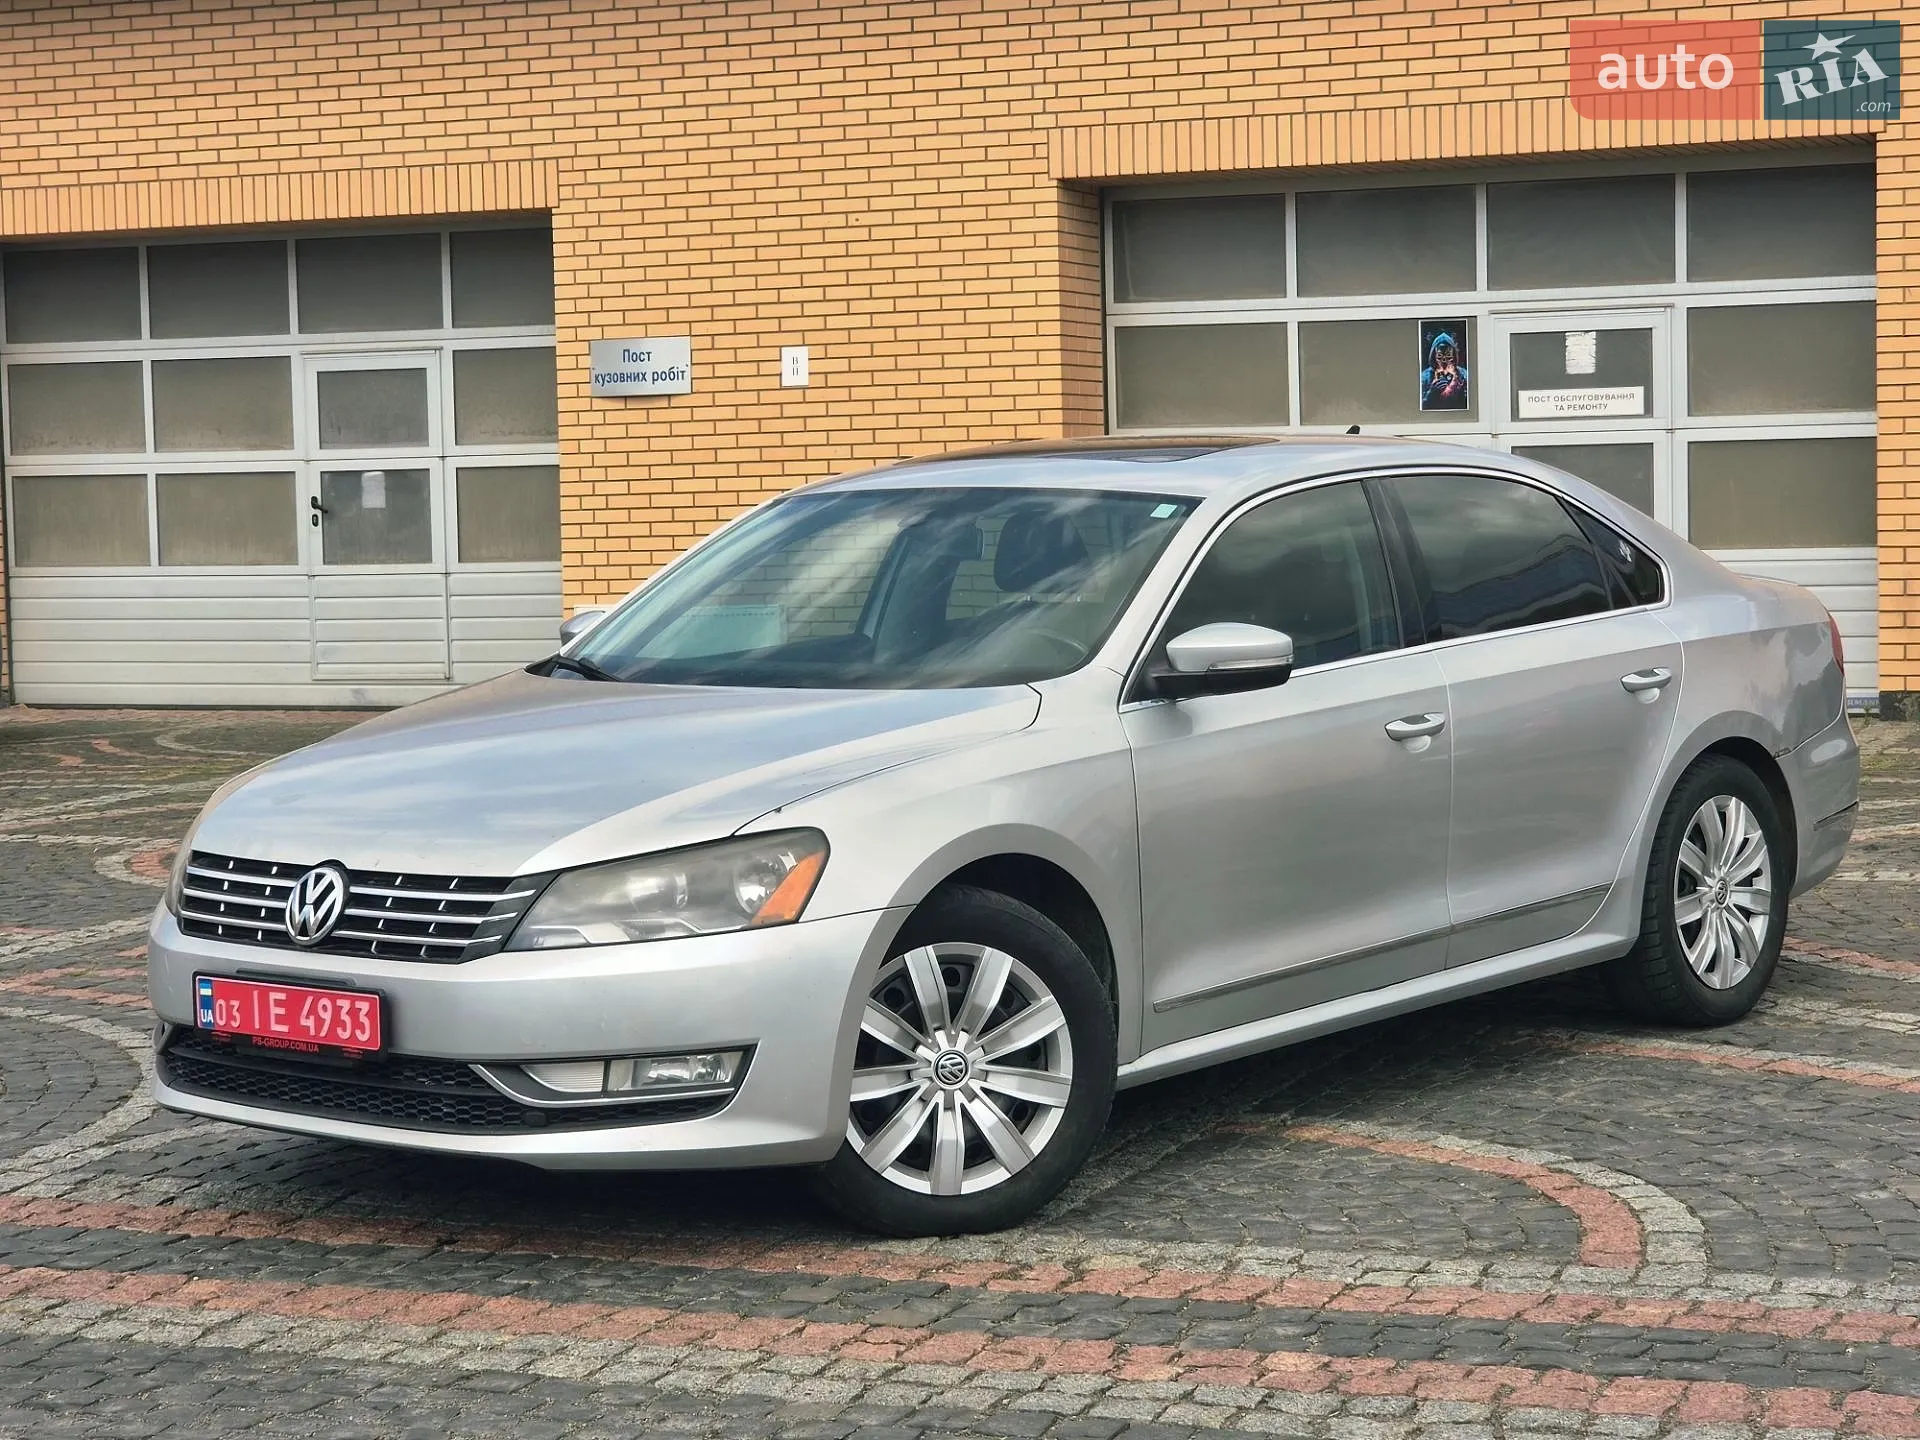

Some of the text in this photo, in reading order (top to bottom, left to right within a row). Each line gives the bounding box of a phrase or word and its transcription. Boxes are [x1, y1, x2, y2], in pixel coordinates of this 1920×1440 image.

[623, 349, 652, 363] Пост
[594, 366, 686, 387] кузовних робіт
[1528, 393, 1635, 403] ПОСТ ОБСЛУГОВУВАННЯ
[1567, 403, 1608, 411] РЕМОНТУ
[201, 990, 371, 1042] UA 03 IE 4933
